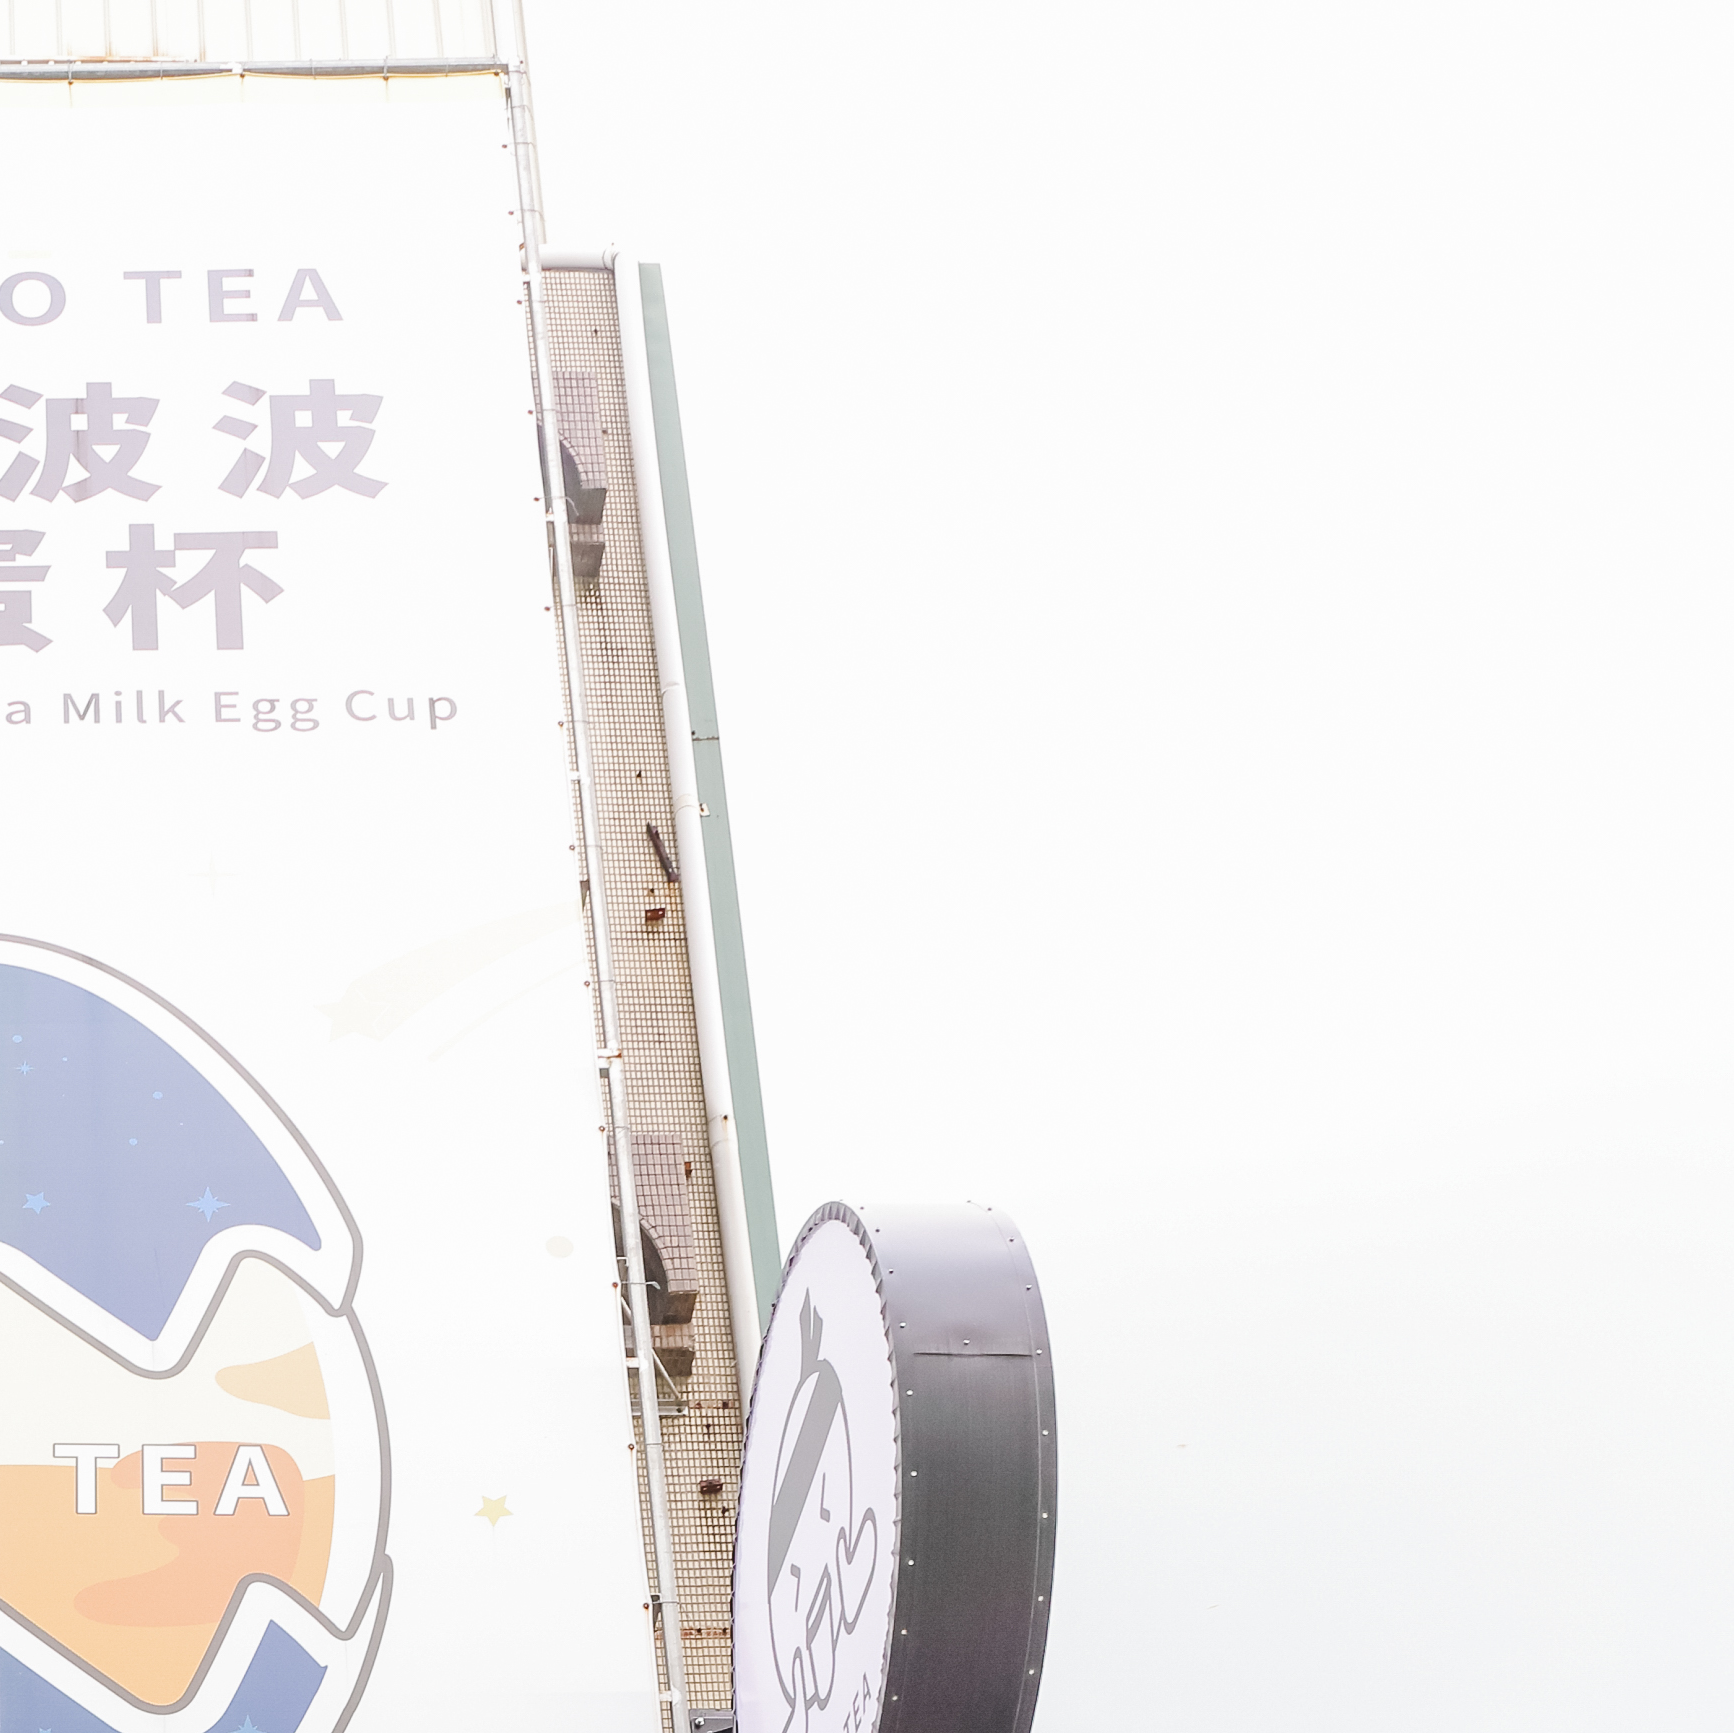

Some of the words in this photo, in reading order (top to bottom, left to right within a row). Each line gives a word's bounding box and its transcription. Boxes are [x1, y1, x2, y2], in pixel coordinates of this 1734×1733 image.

[122, 267, 345, 325] TEA
[61, 688, 187, 726] Milk
[212, 690, 321, 734] Egg
[343, 687, 460, 731] Cup
[52, 1442, 291, 1518] TEA
